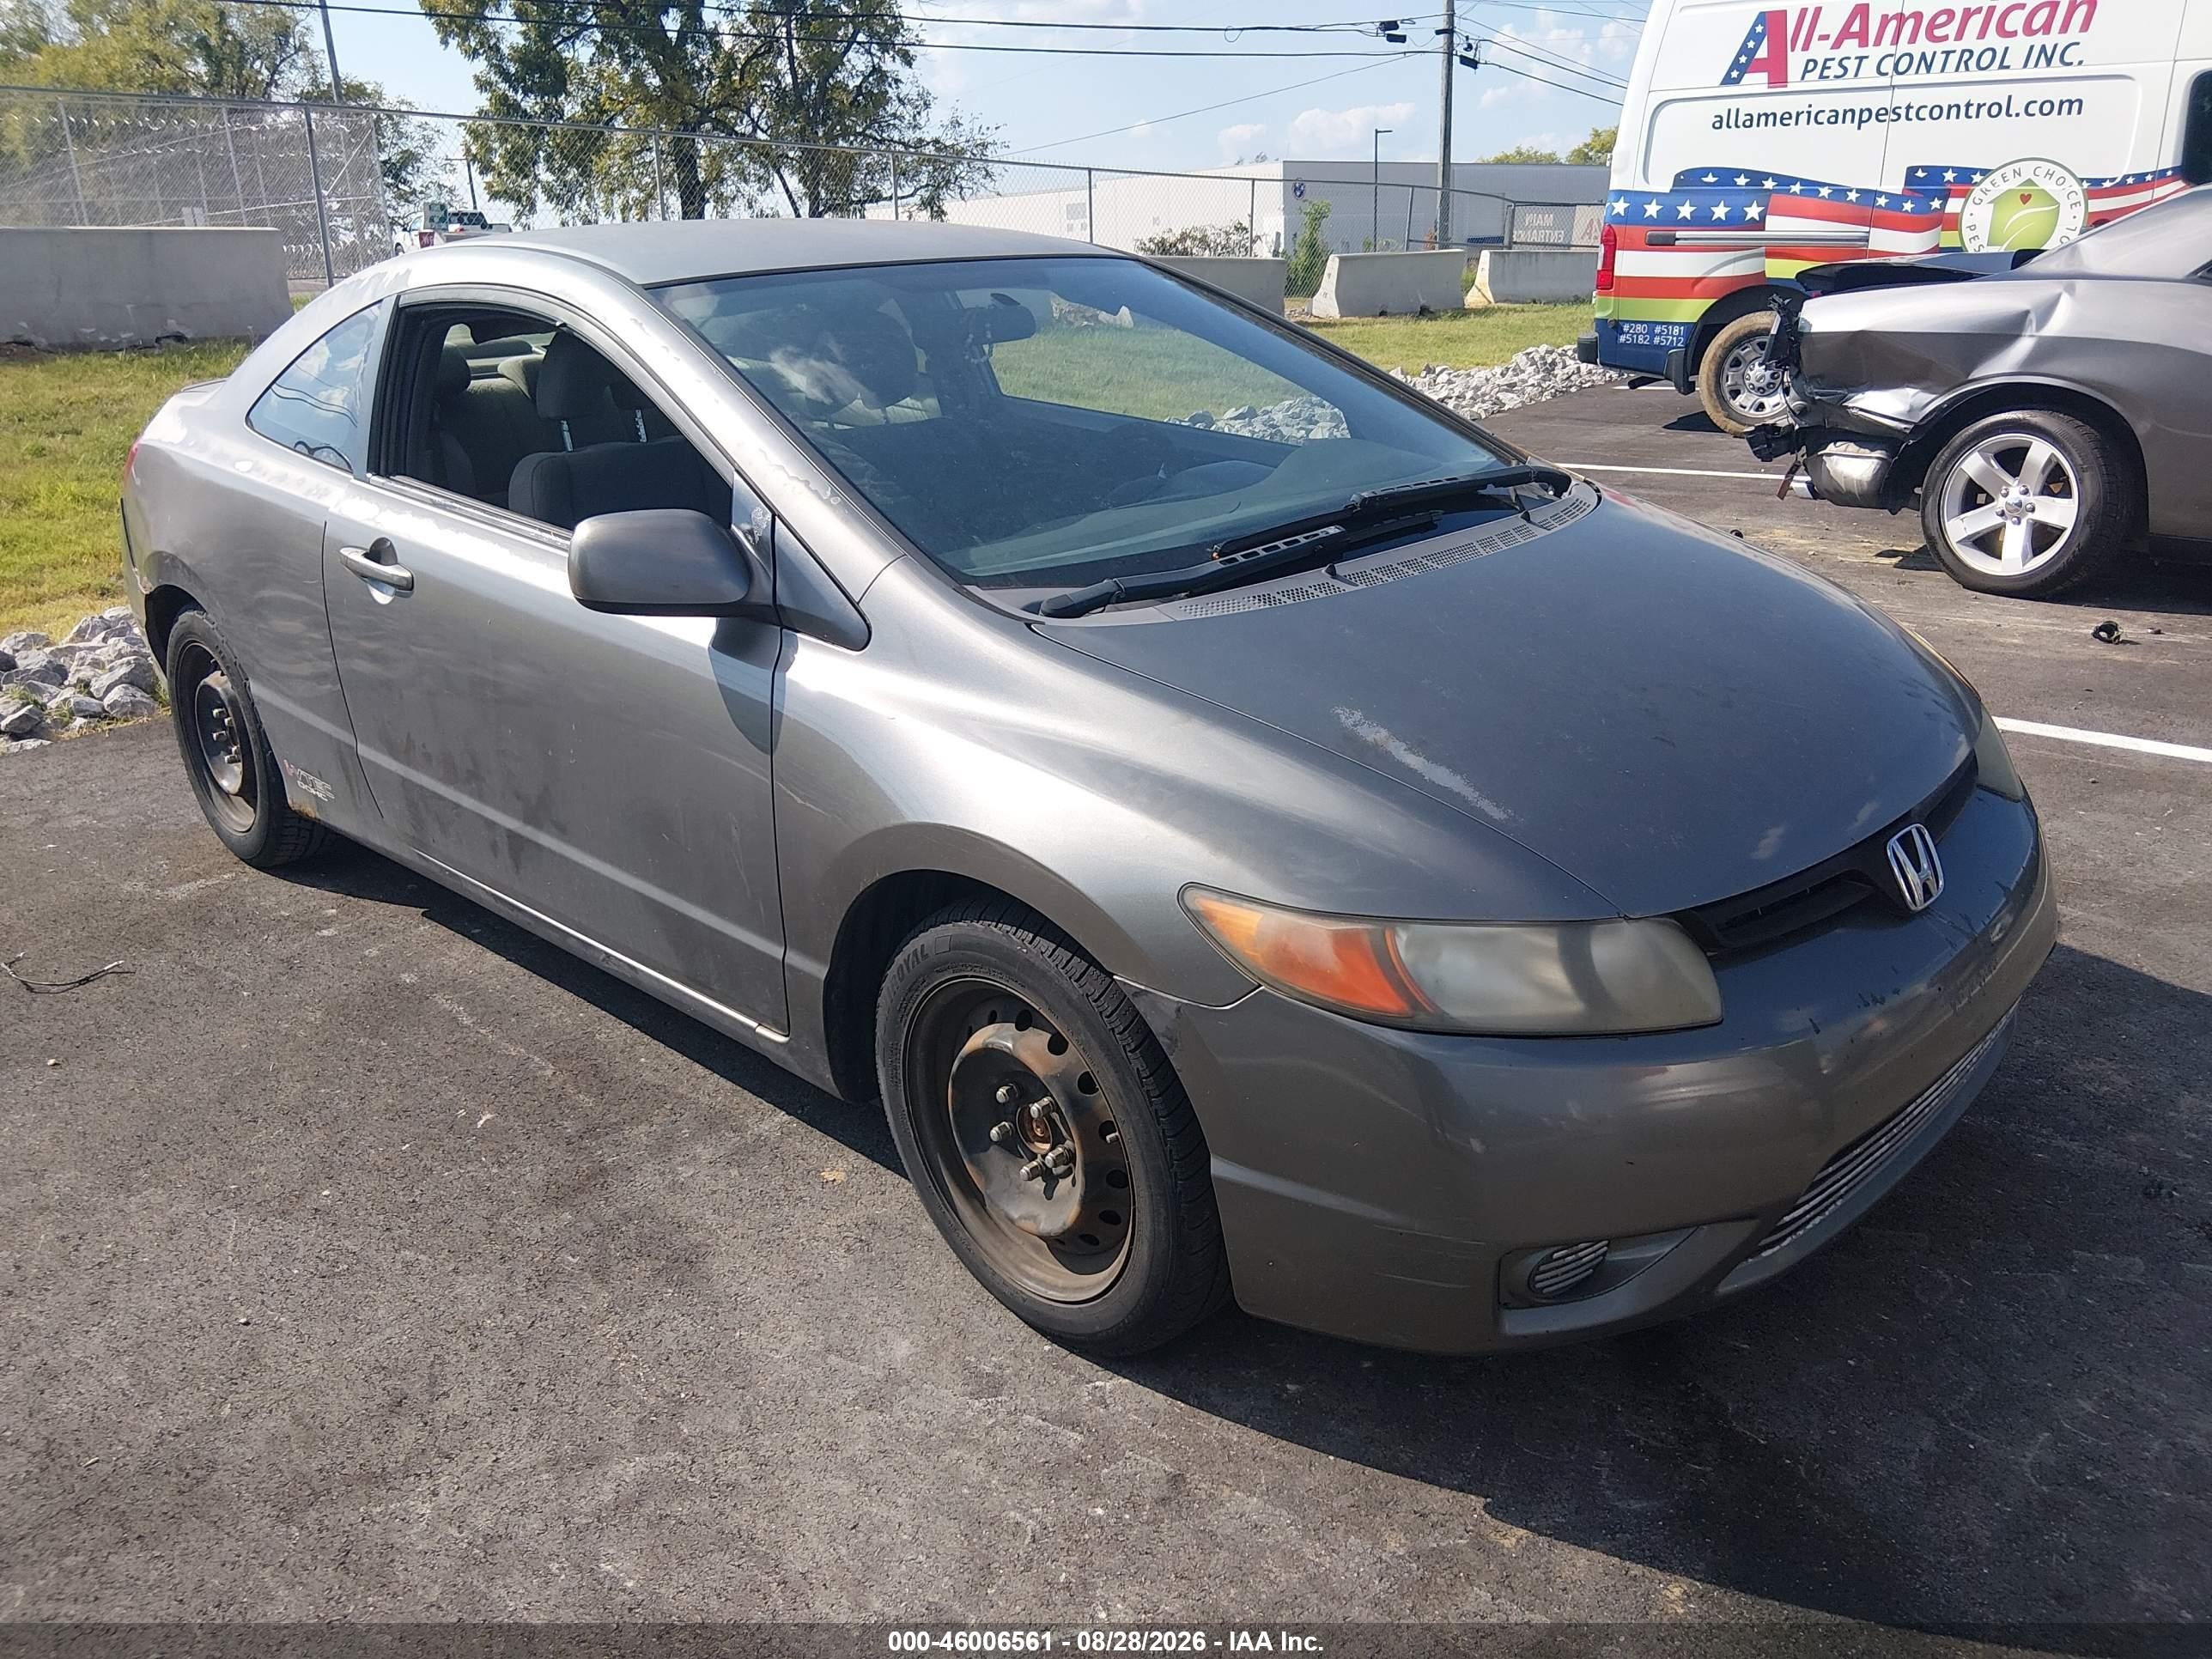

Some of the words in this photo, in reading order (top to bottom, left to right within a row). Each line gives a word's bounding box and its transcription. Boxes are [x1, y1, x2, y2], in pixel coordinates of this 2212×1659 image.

[1720, 0, 2098, 88] All-American
[1801, 55, 1869, 81] PEST
[1875, 46, 2010, 77] CONTROL
[2021, 41, 2084, 70] INC.
[1711, 94, 2084, 131] allamericanpestcontrol.com
[1972, 167, 2022, 206] GREEN
[1966, 224, 1986, 252] PES
[1620, 333, 1650, 344] #5182
[1653, 335, 1685, 347] #5712
[1622, 324, 1648, 334] #280
[1654, 325, 1685, 336] #5181
